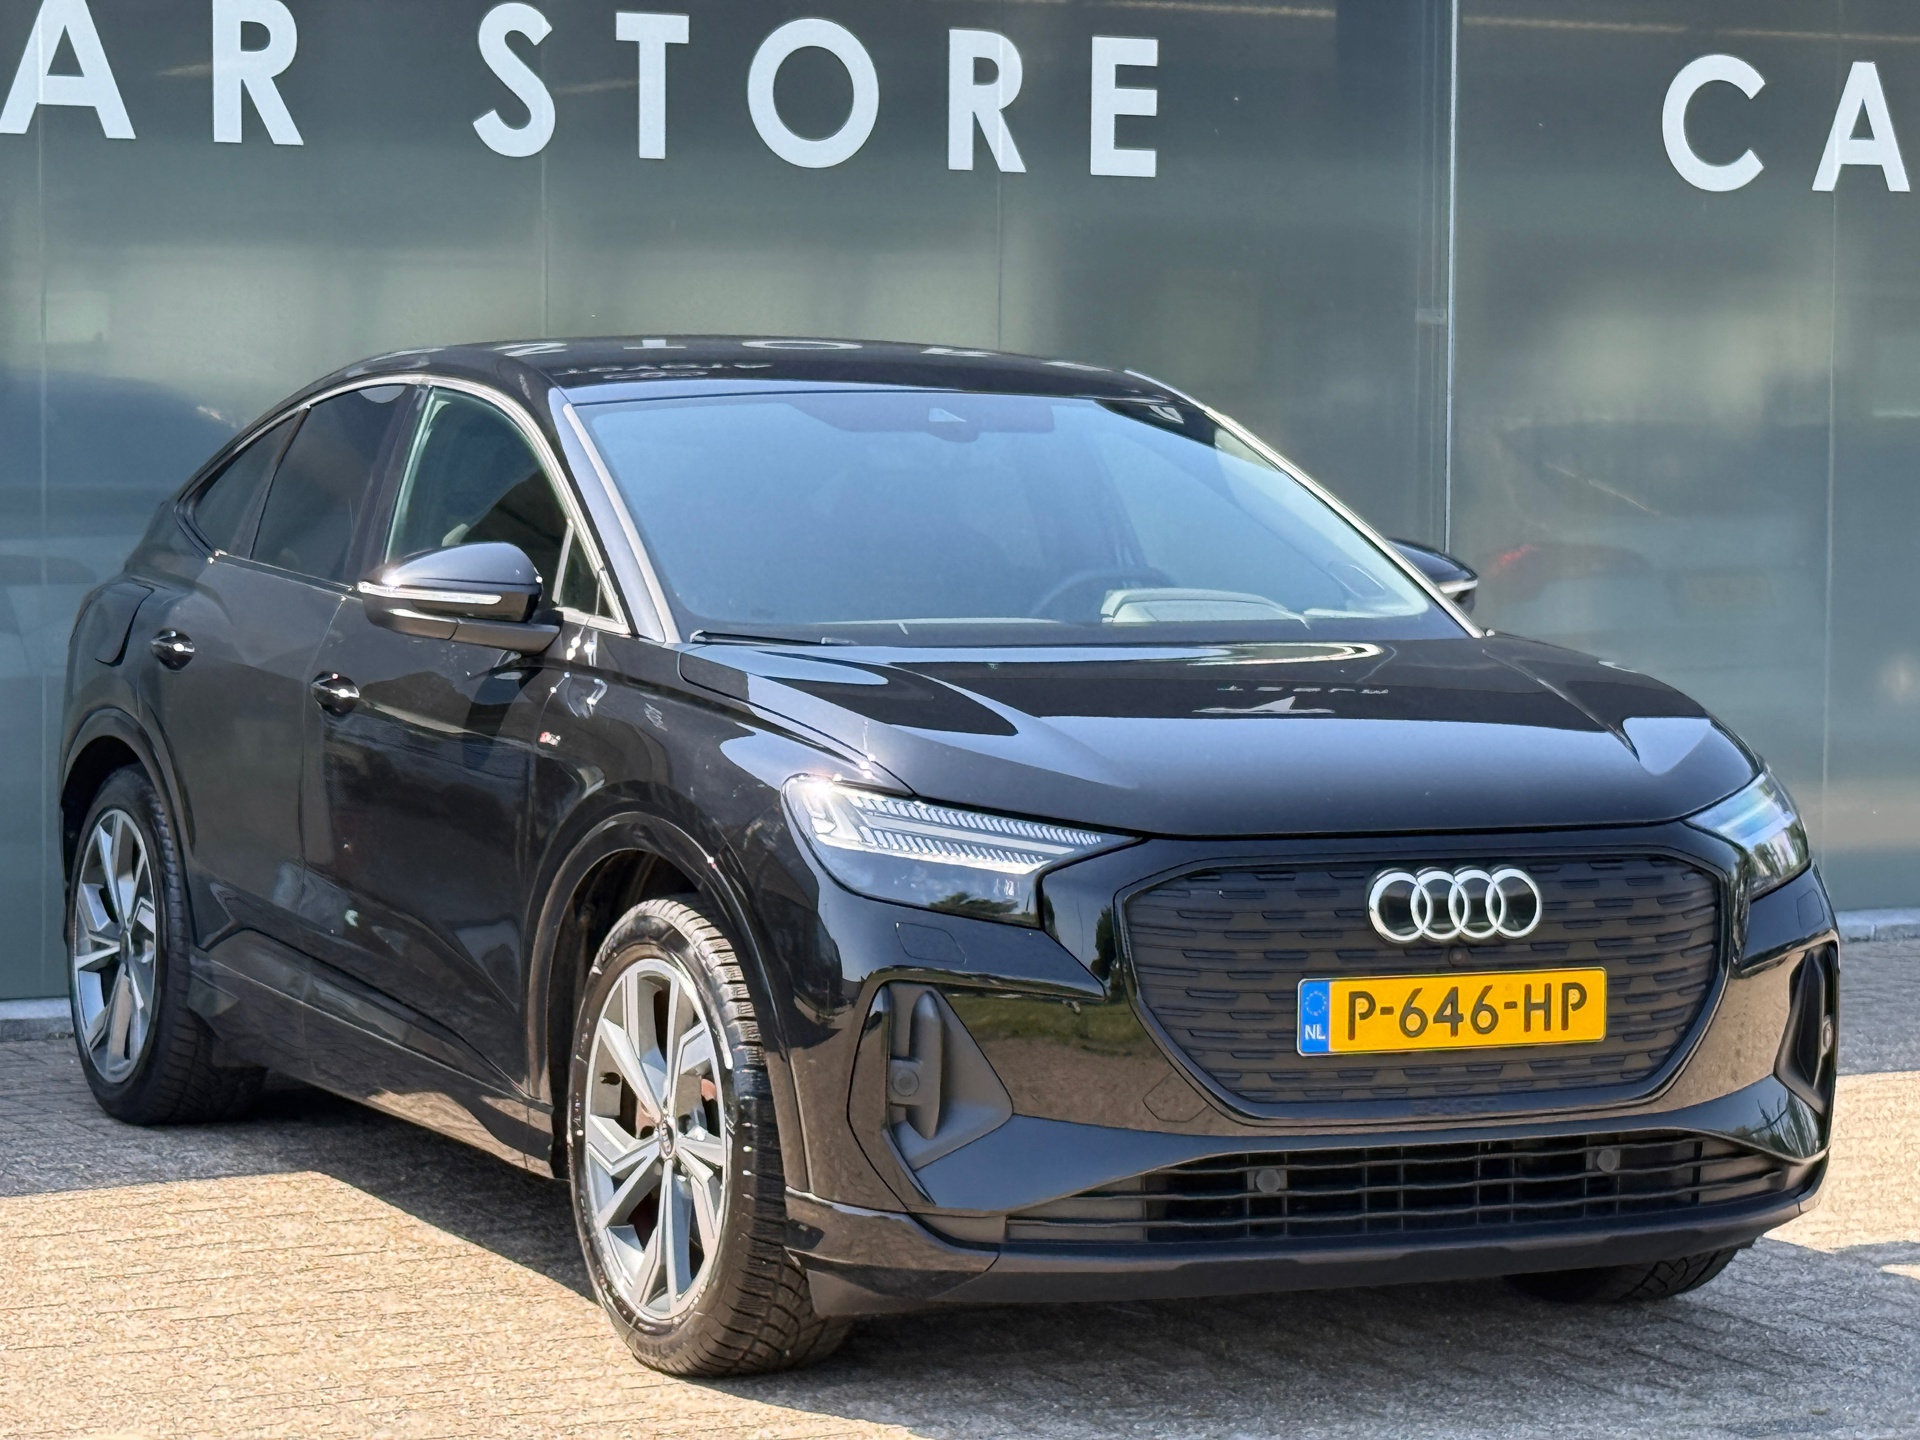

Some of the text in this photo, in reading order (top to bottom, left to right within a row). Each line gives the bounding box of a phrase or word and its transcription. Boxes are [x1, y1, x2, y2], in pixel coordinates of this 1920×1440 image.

[473, 2, 1159, 178] STORE
[1662, 53, 1911, 192] CA
[1304, 981, 1588, 1041] NL P-646-HP
